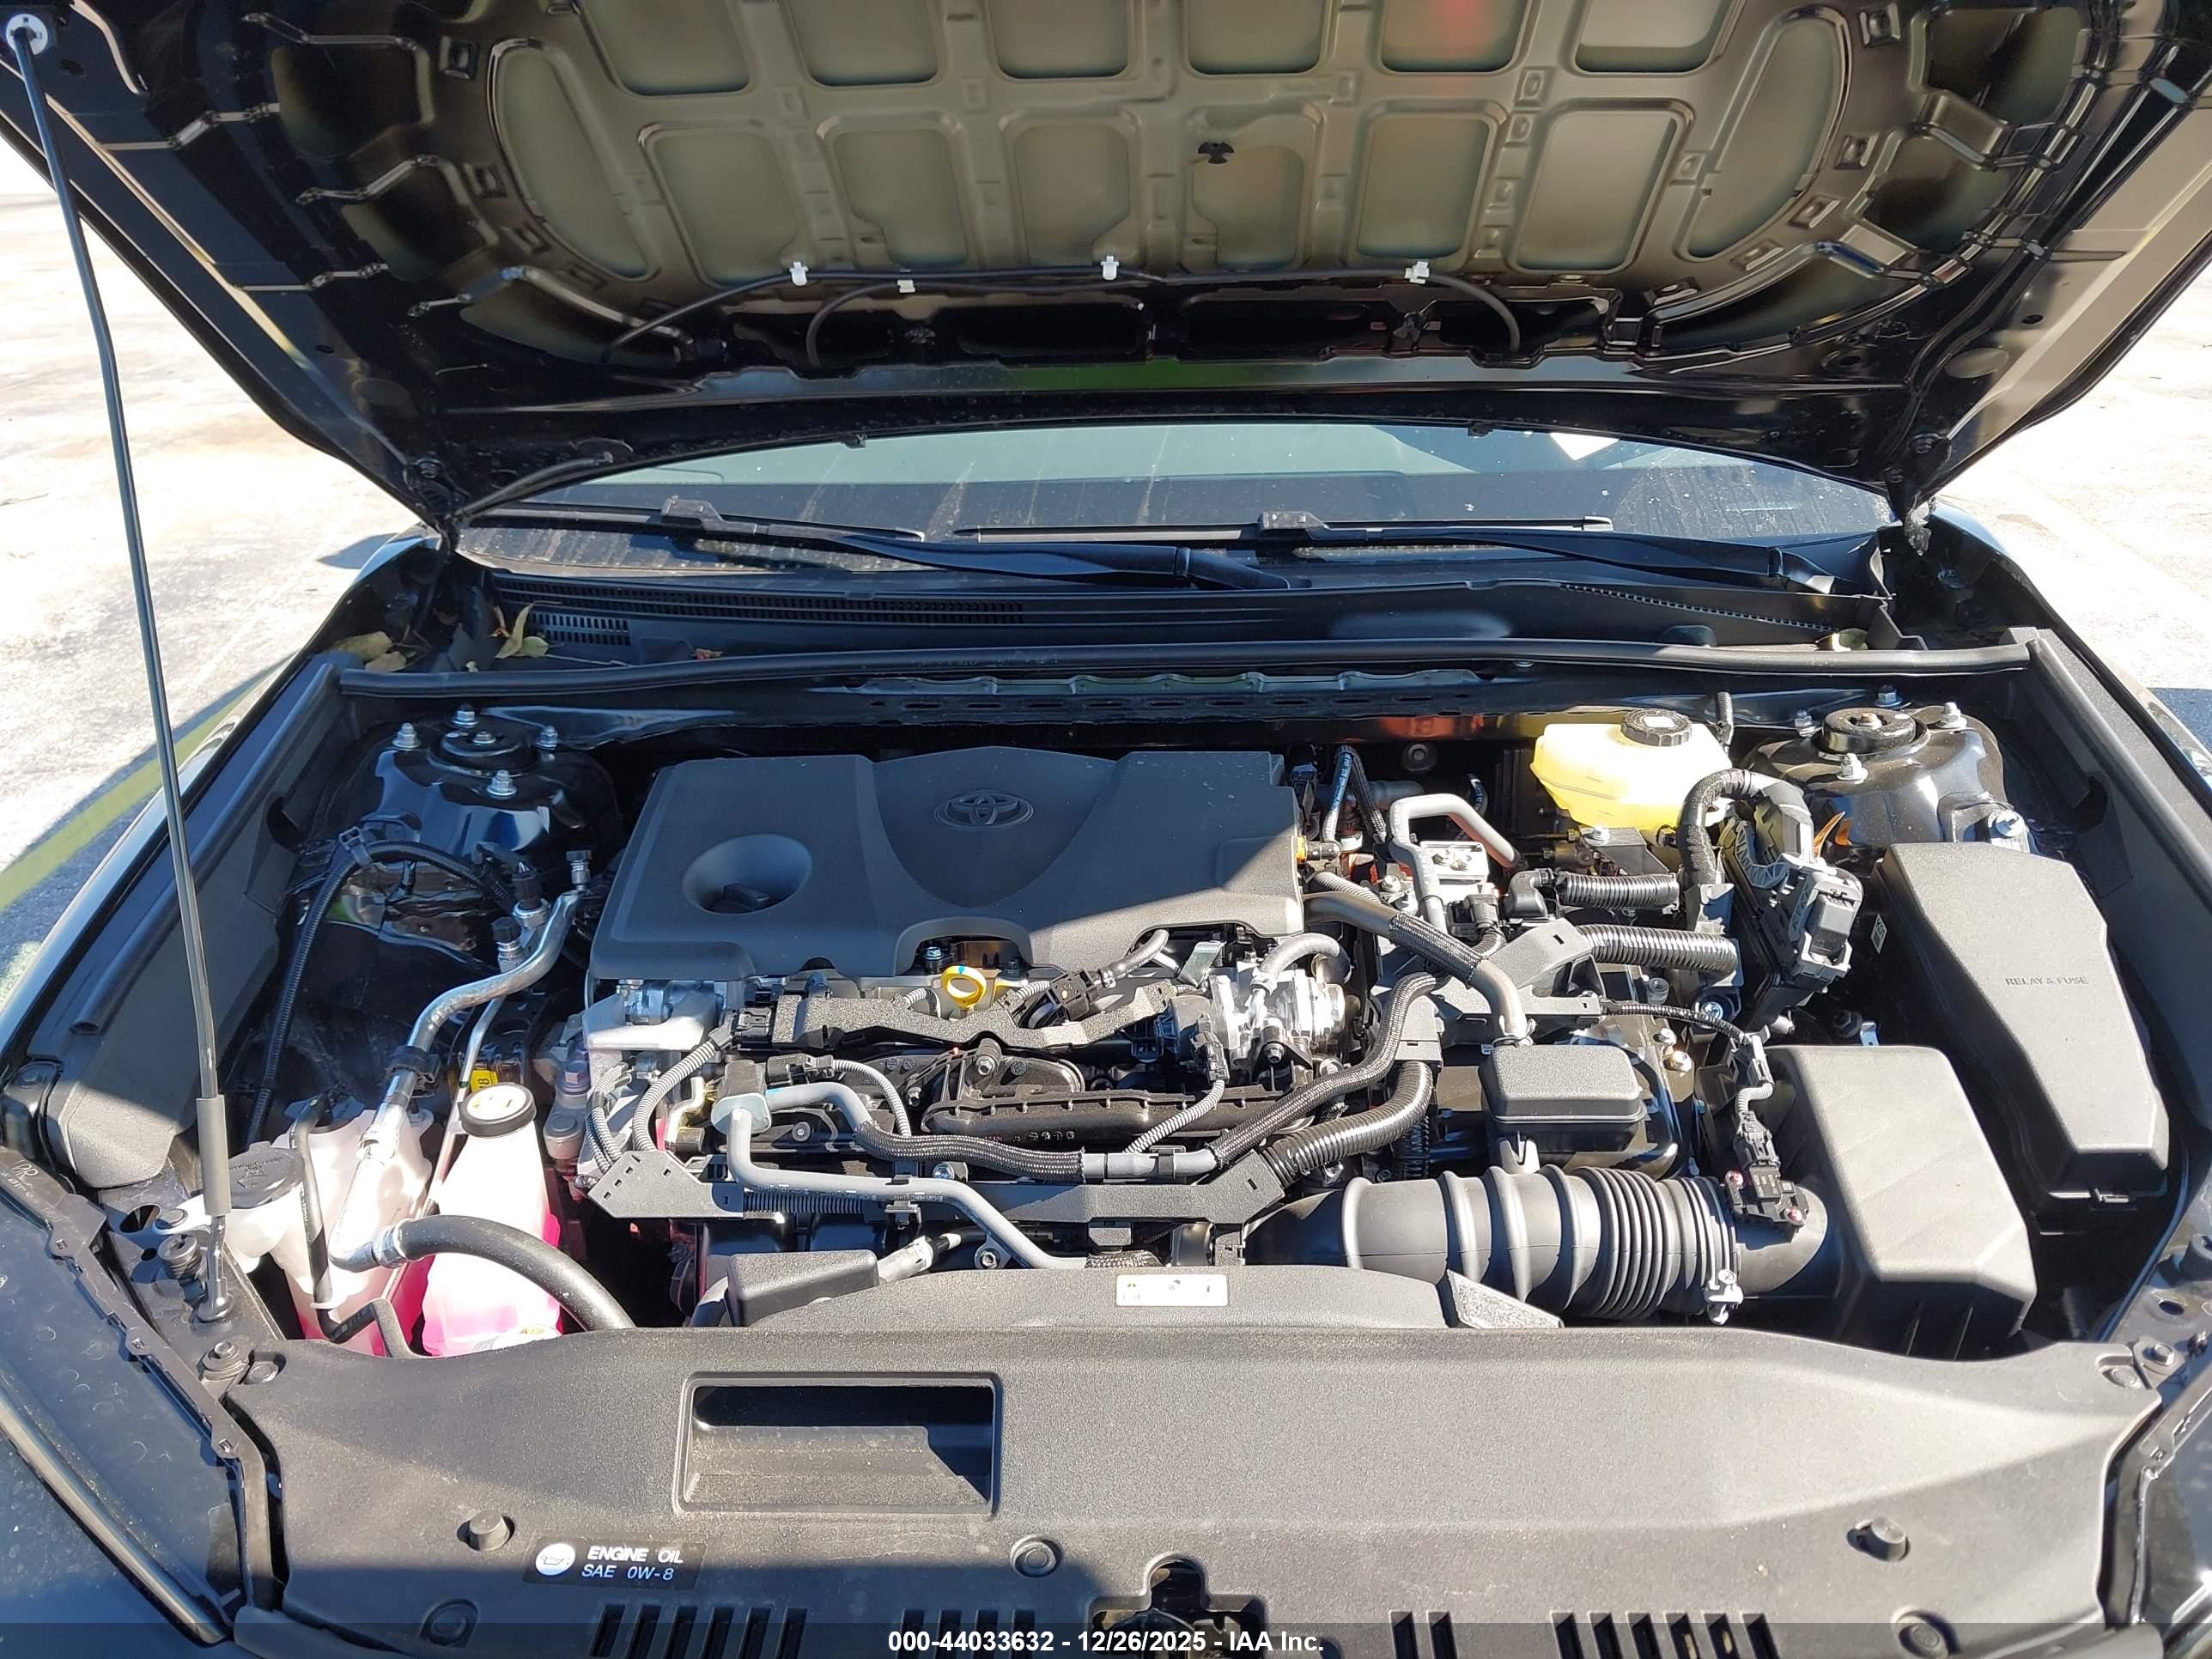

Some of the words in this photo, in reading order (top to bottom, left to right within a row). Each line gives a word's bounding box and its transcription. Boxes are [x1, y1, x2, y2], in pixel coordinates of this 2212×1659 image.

[2005, 977, 2044, 986] RELAY
[2057, 976, 2089, 985] FUSE
[586, 1547, 648, 1563] ENGINE
[657, 1547, 684, 1564] OIL
[581, 1564, 616, 1579] SAE
[627, 1566, 675, 1582] 0W-8
